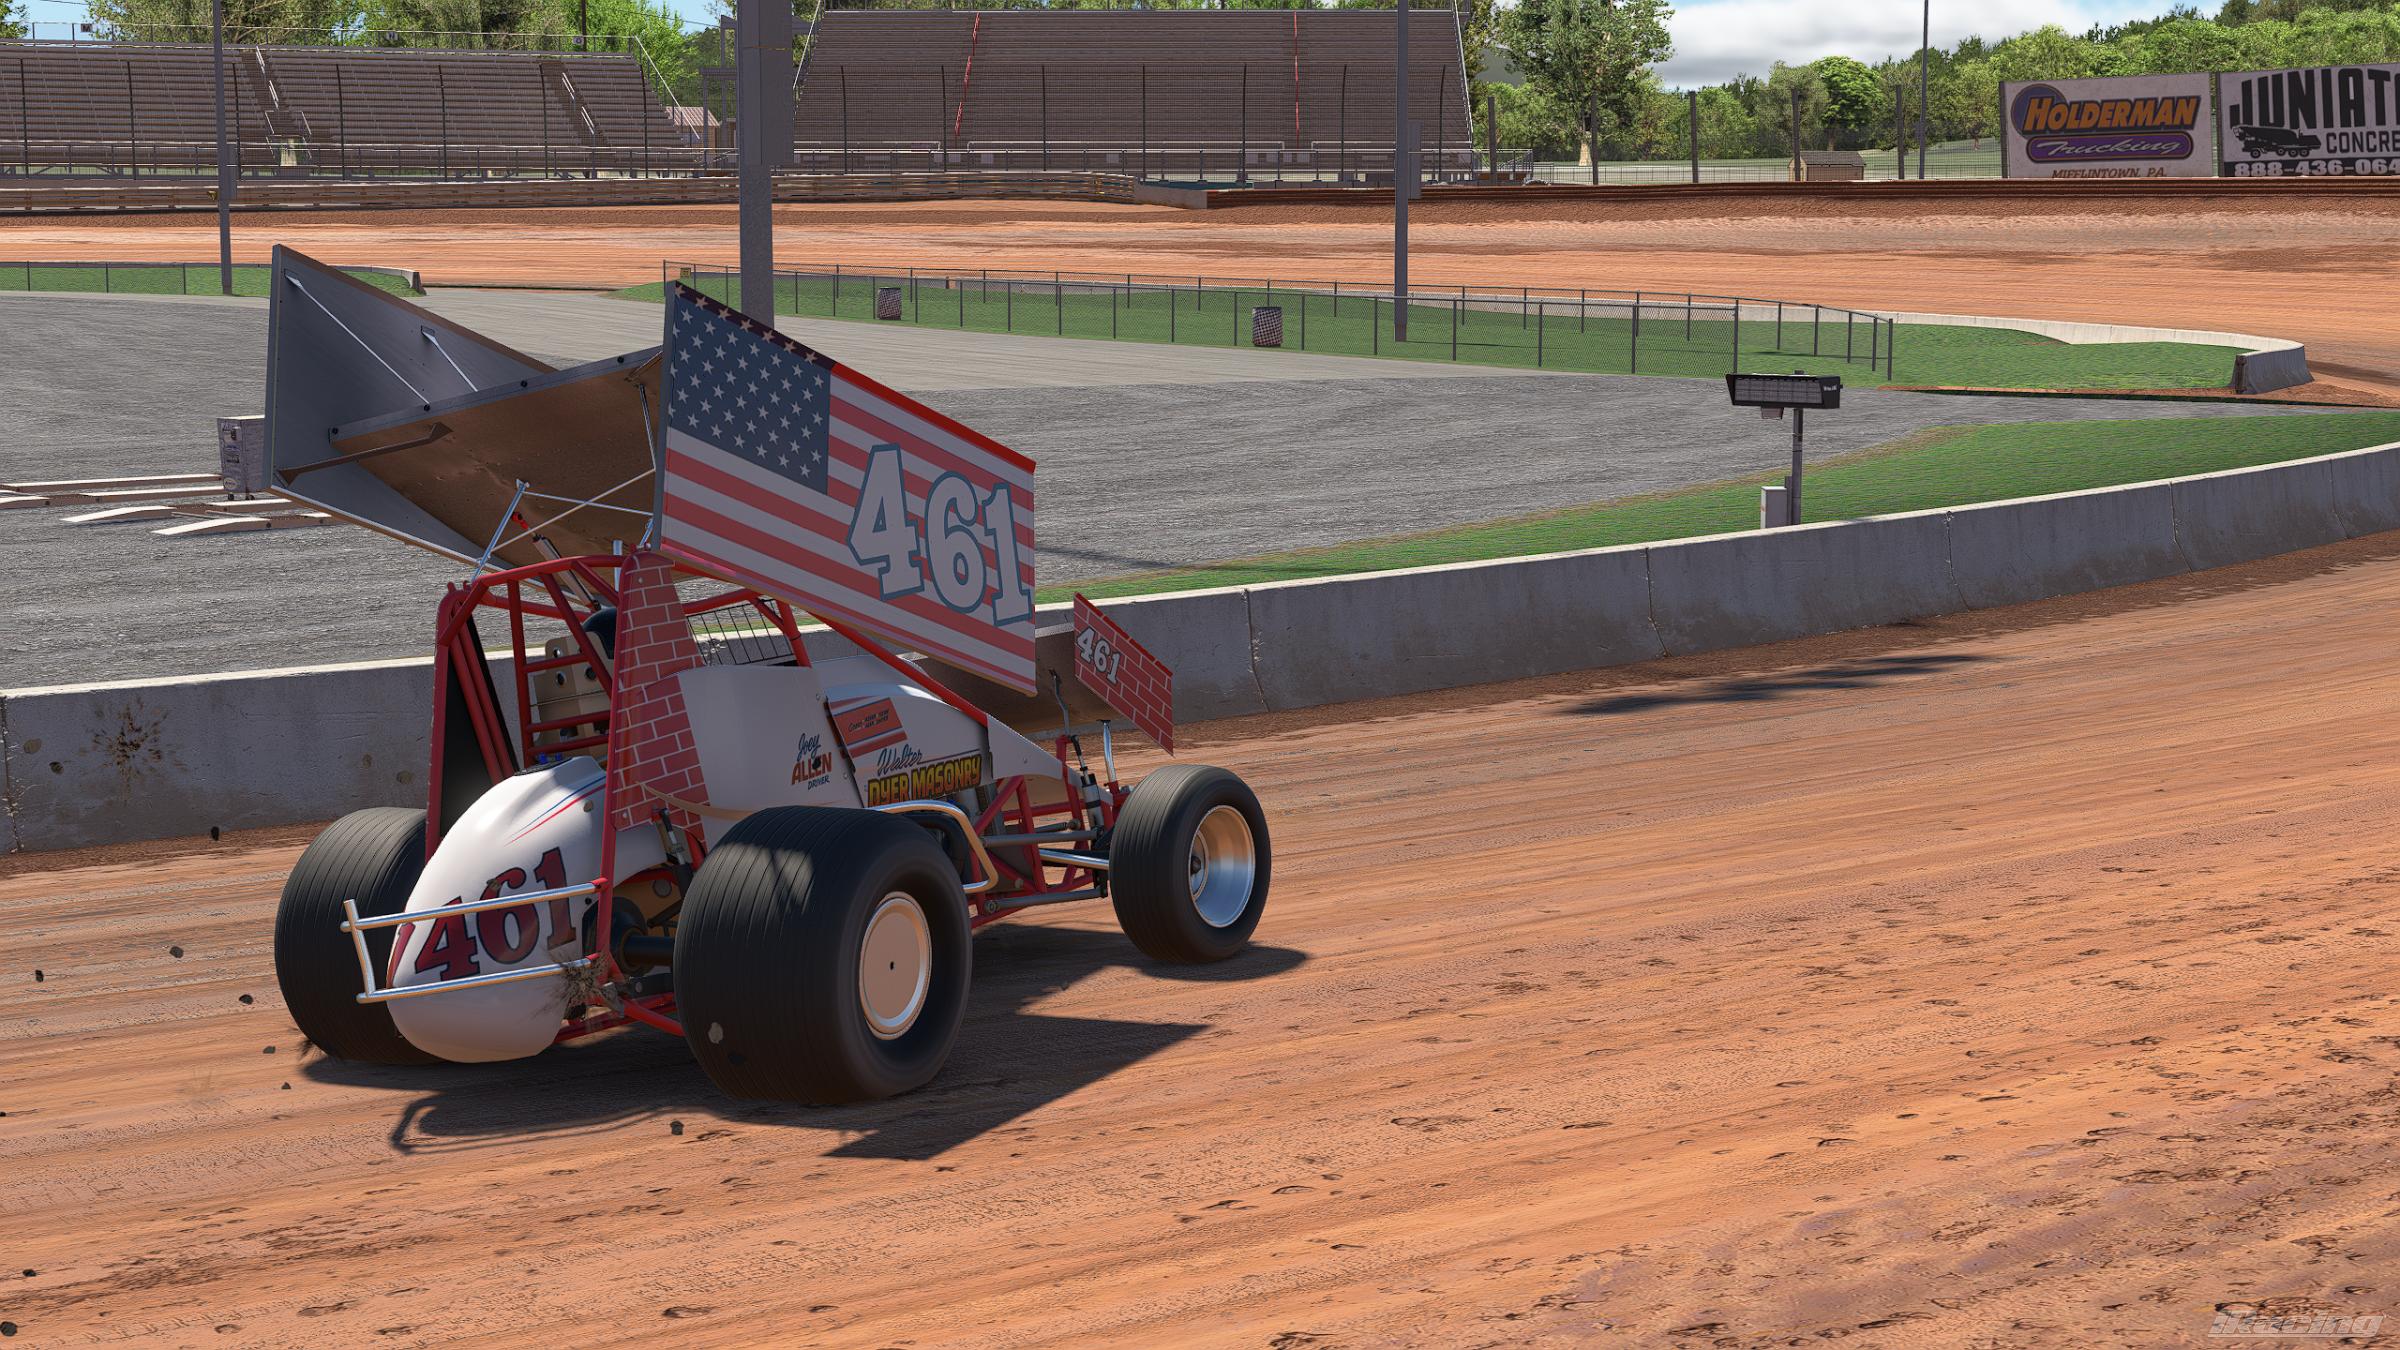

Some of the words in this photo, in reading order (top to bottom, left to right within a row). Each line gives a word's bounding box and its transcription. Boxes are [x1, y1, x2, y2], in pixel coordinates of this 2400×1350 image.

[2022, 96, 2201, 132] HOLDERMAN
[2229, 68, 2400, 129] JUNIAT
[2036, 138, 2182, 156] Trucking
[846, 443, 1033, 627] 461
[1076, 626, 1120, 685] 461
[797, 732, 821, 761] Joey
[877, 743, 923, 776] Walter
[791, 751, 832, 785] ALLEN
[807, 775, 830, 790] DRIVER
[868, 772, 911, 808] DYER
[911, 754, 981, 800] MASONRY
[415, 846, 576, 982] 461
